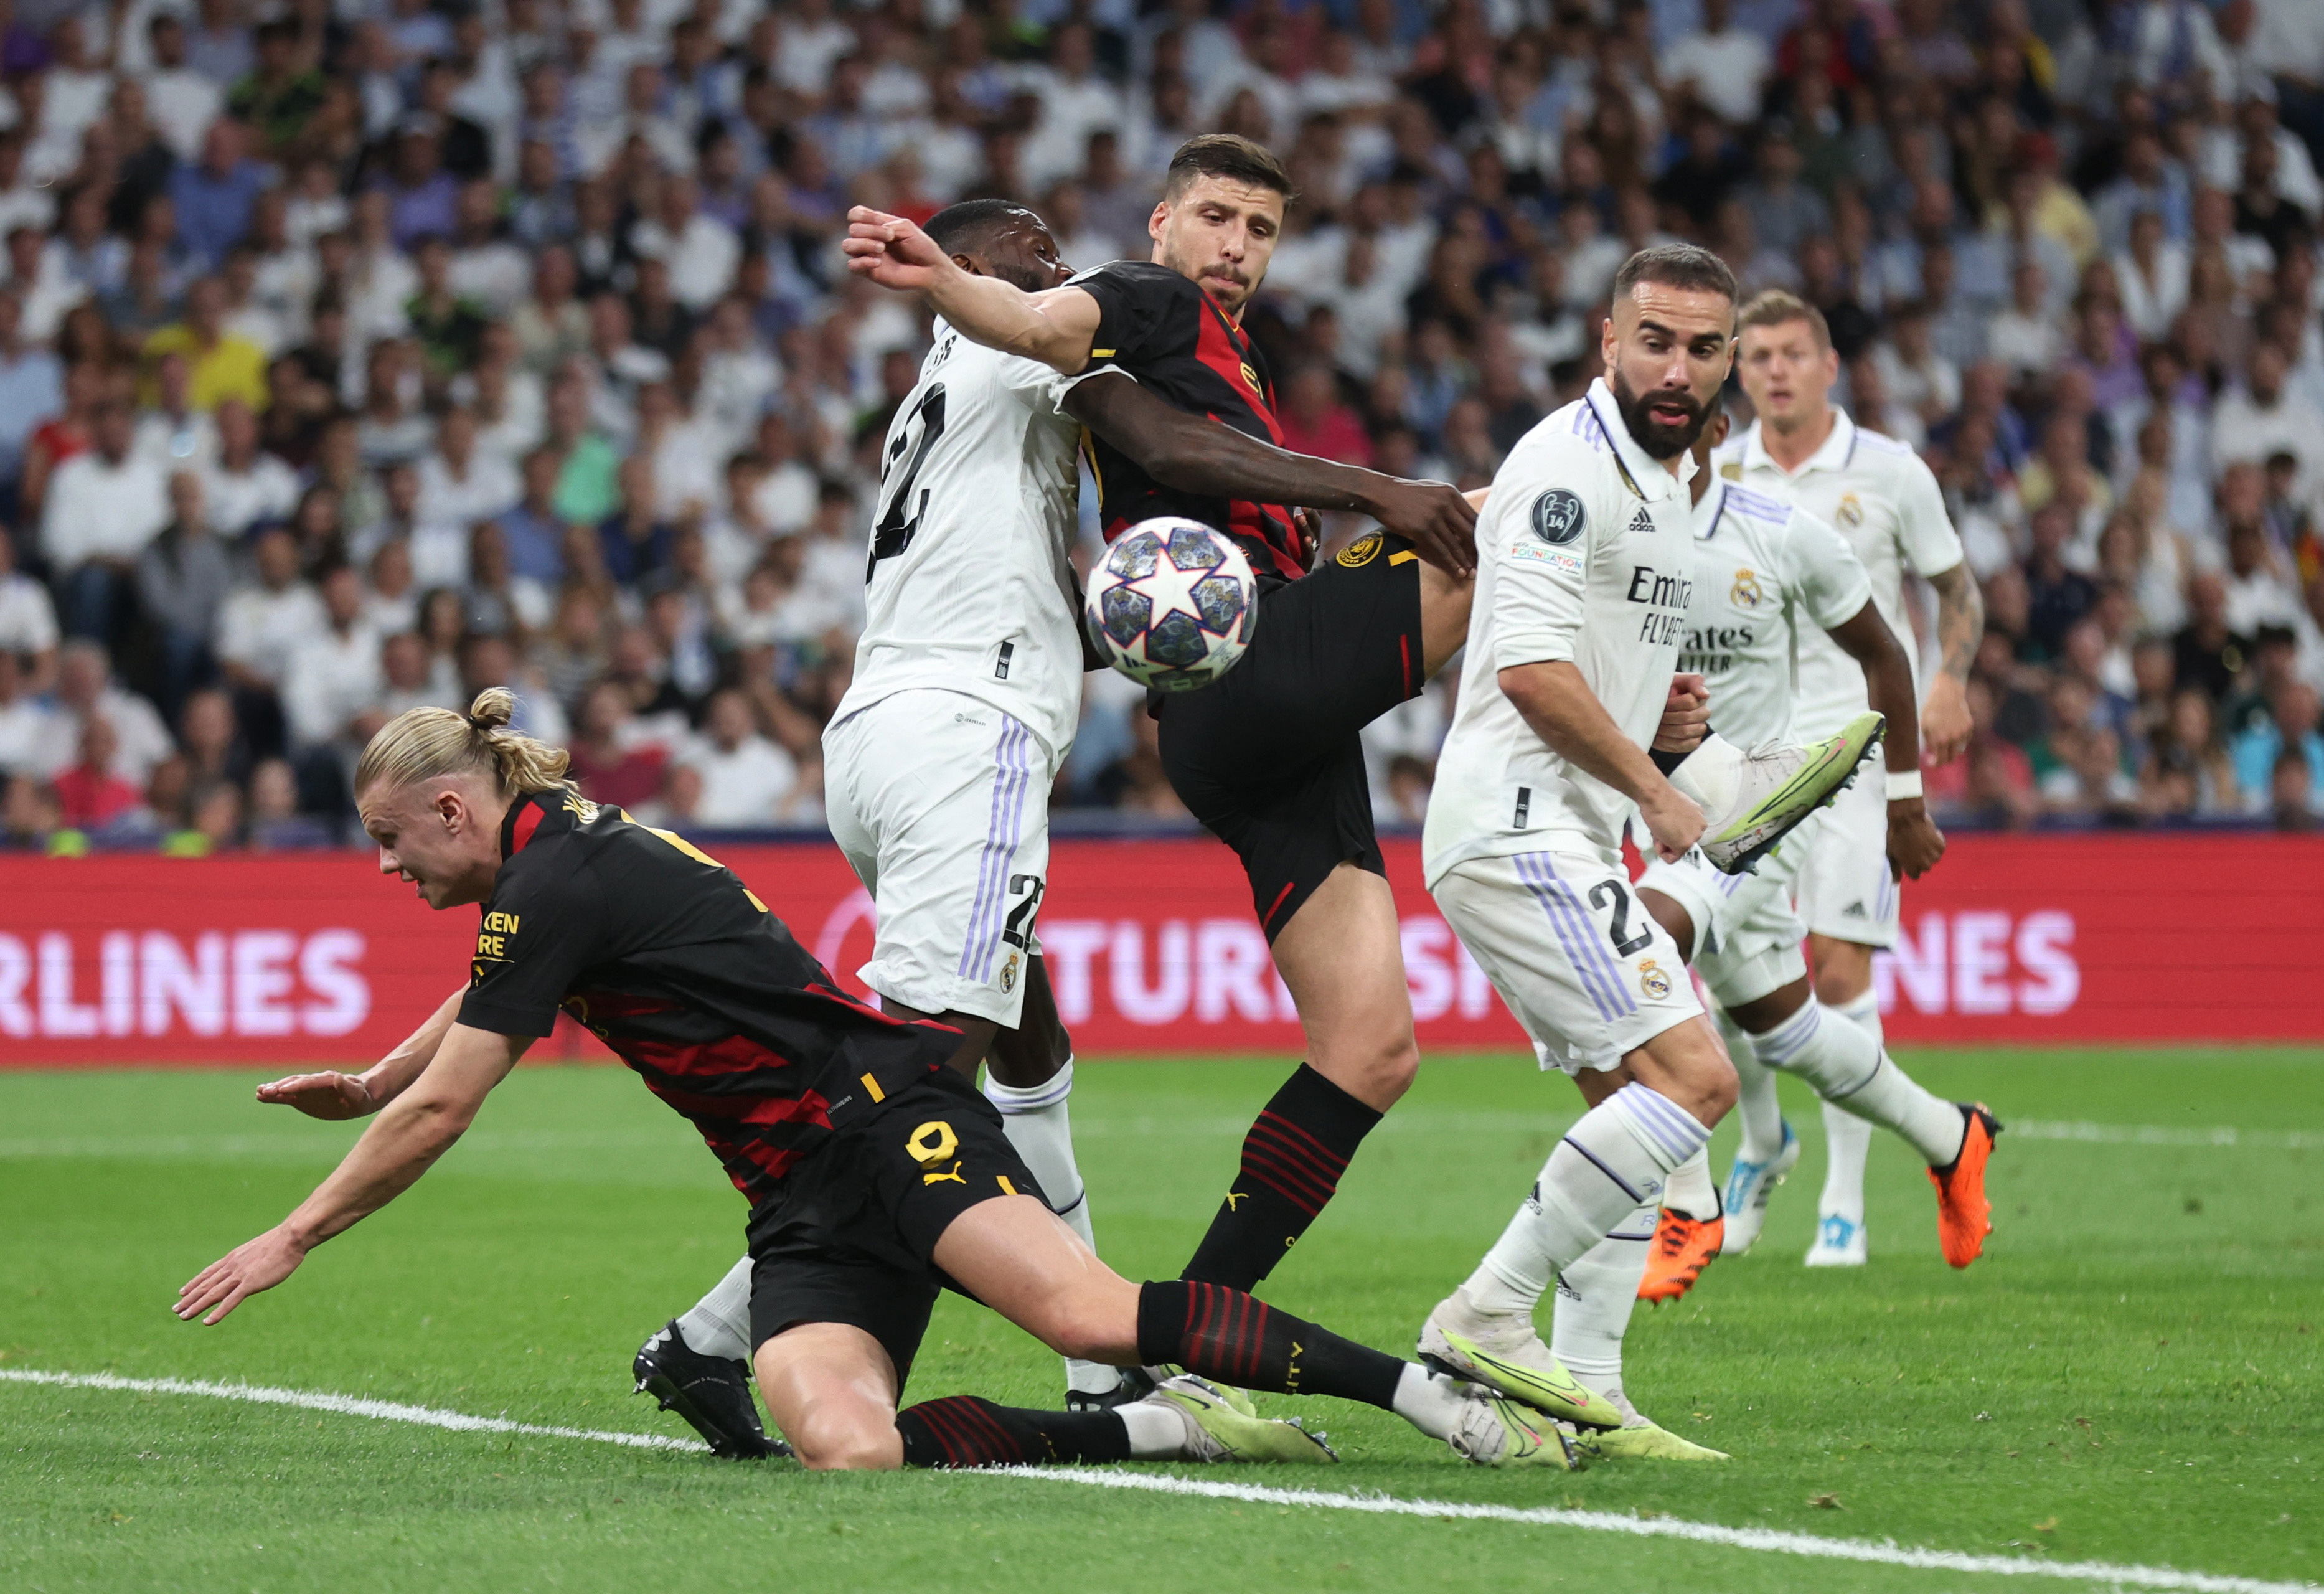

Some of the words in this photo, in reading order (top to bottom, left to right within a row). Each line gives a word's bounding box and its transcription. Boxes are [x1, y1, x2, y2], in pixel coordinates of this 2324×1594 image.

[1547, 514, 1565, 530] 14
[1629, 522, 1657, 533] adidas
[1512, 548, 1583, 569] FOUNDATION
[1681, 624, 1754, 650] ates
[1588, 879, 1653, 958] 2
[478, 934, 505, 957] RE
[905, 1121, 959, 1170] 9
[1286, 1341, 1303, 1394] ITY
